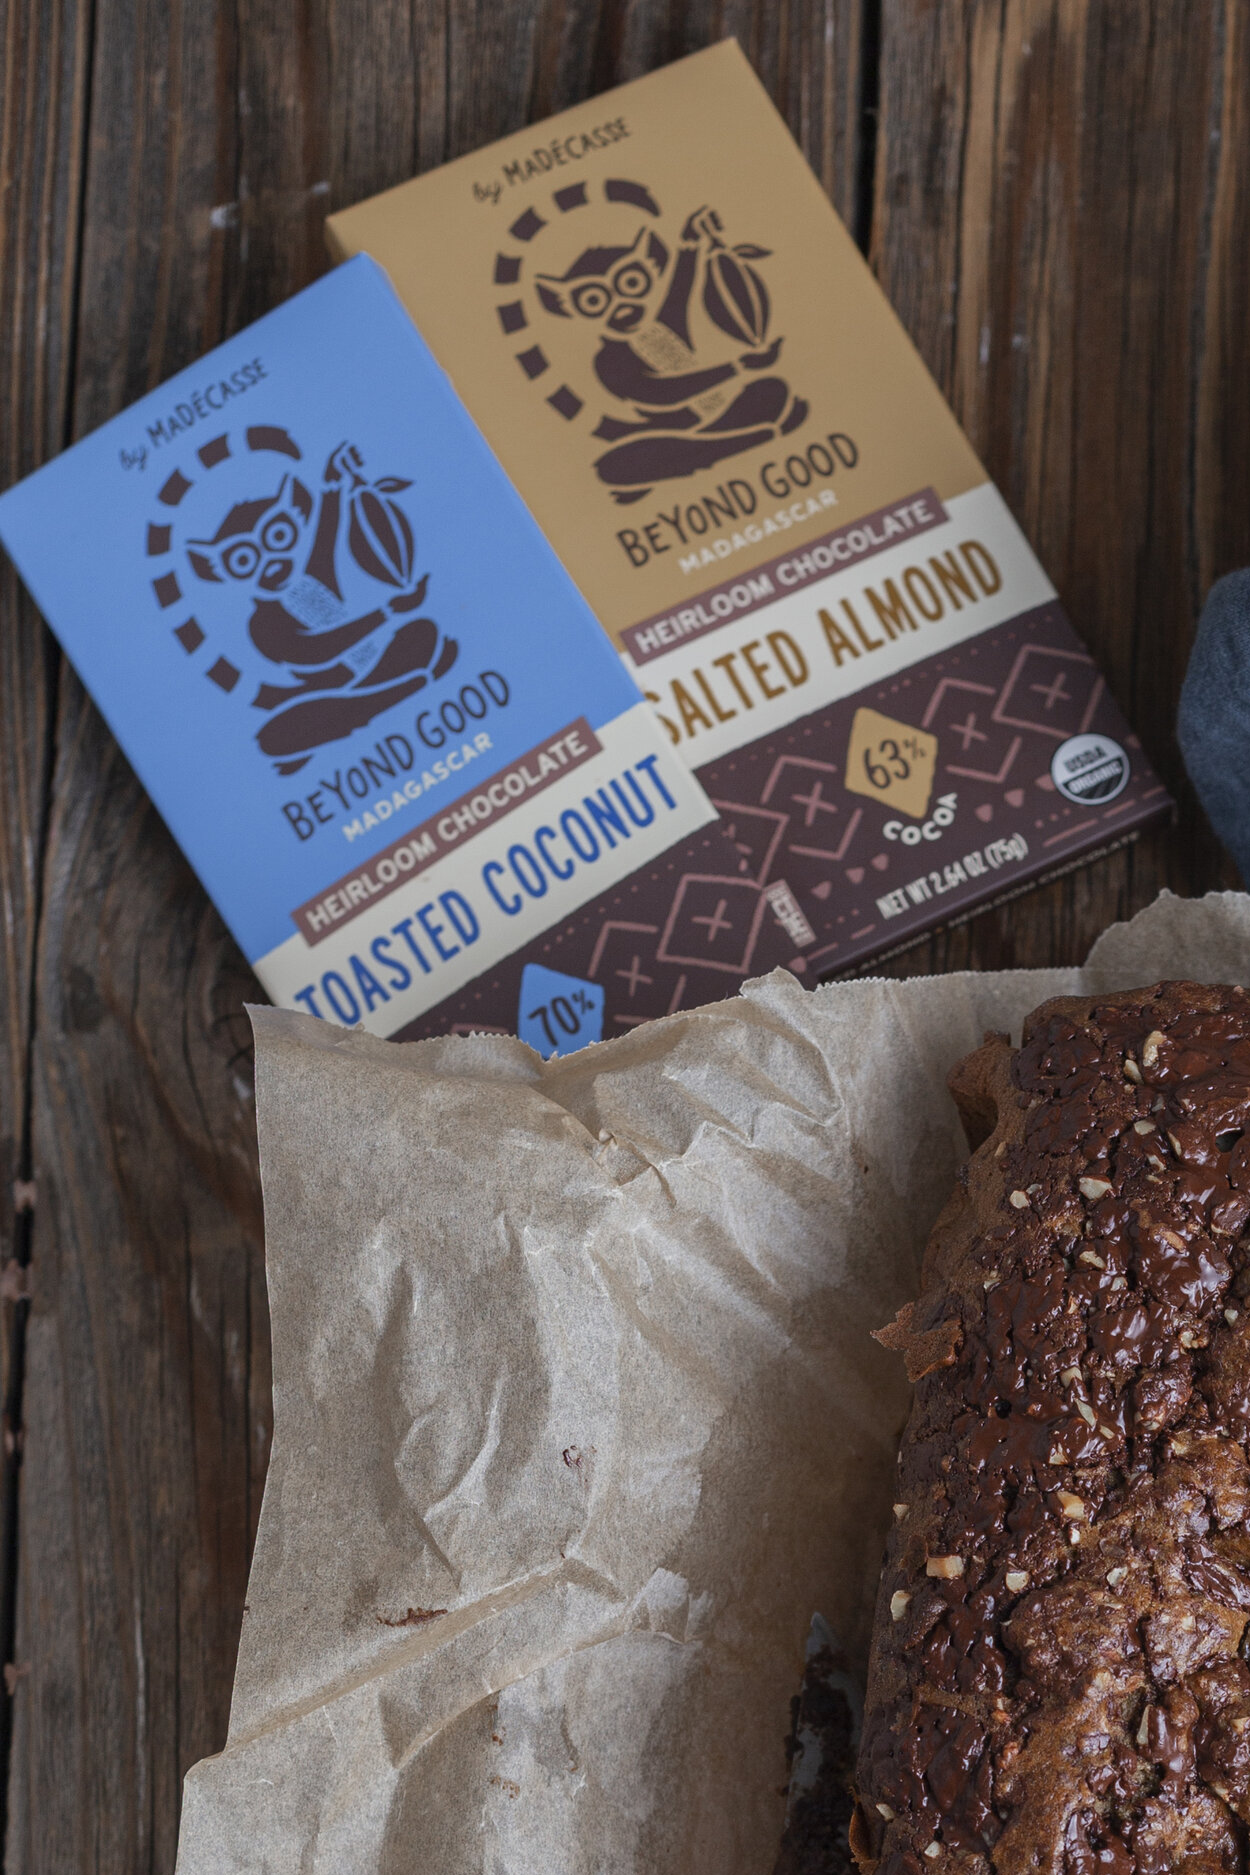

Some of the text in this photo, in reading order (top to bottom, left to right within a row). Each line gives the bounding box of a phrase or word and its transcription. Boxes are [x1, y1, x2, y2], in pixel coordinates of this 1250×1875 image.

[473, 180, 503, 207] by
[119, 446, 147, 471] by
[760, 433, 859, 499] GOOD
[679, 488, 839, 575] MADAGASCAR
[634, 499, 935, 654] HEIRLOOM CHOCOLATE
[817, 540, 1003, 667] ALMOND
[416, 670, 511, 749] GOOD
[342, 732, 494, 842] MADAGASCAR
[863, 736, 927, 790] 63%
[305, 730, 589, 933] HEIRLOOM CHOCOLATE
[882, 792, 958, 846] COCOA
[294, 889, 481, 1026] TOASTED
[482, 754, 678, 917] COCONUT
[875, 888, 910, 920] NET
[905, 876, 934, 905] WT
[528, 989, 596, 1048] 70%
